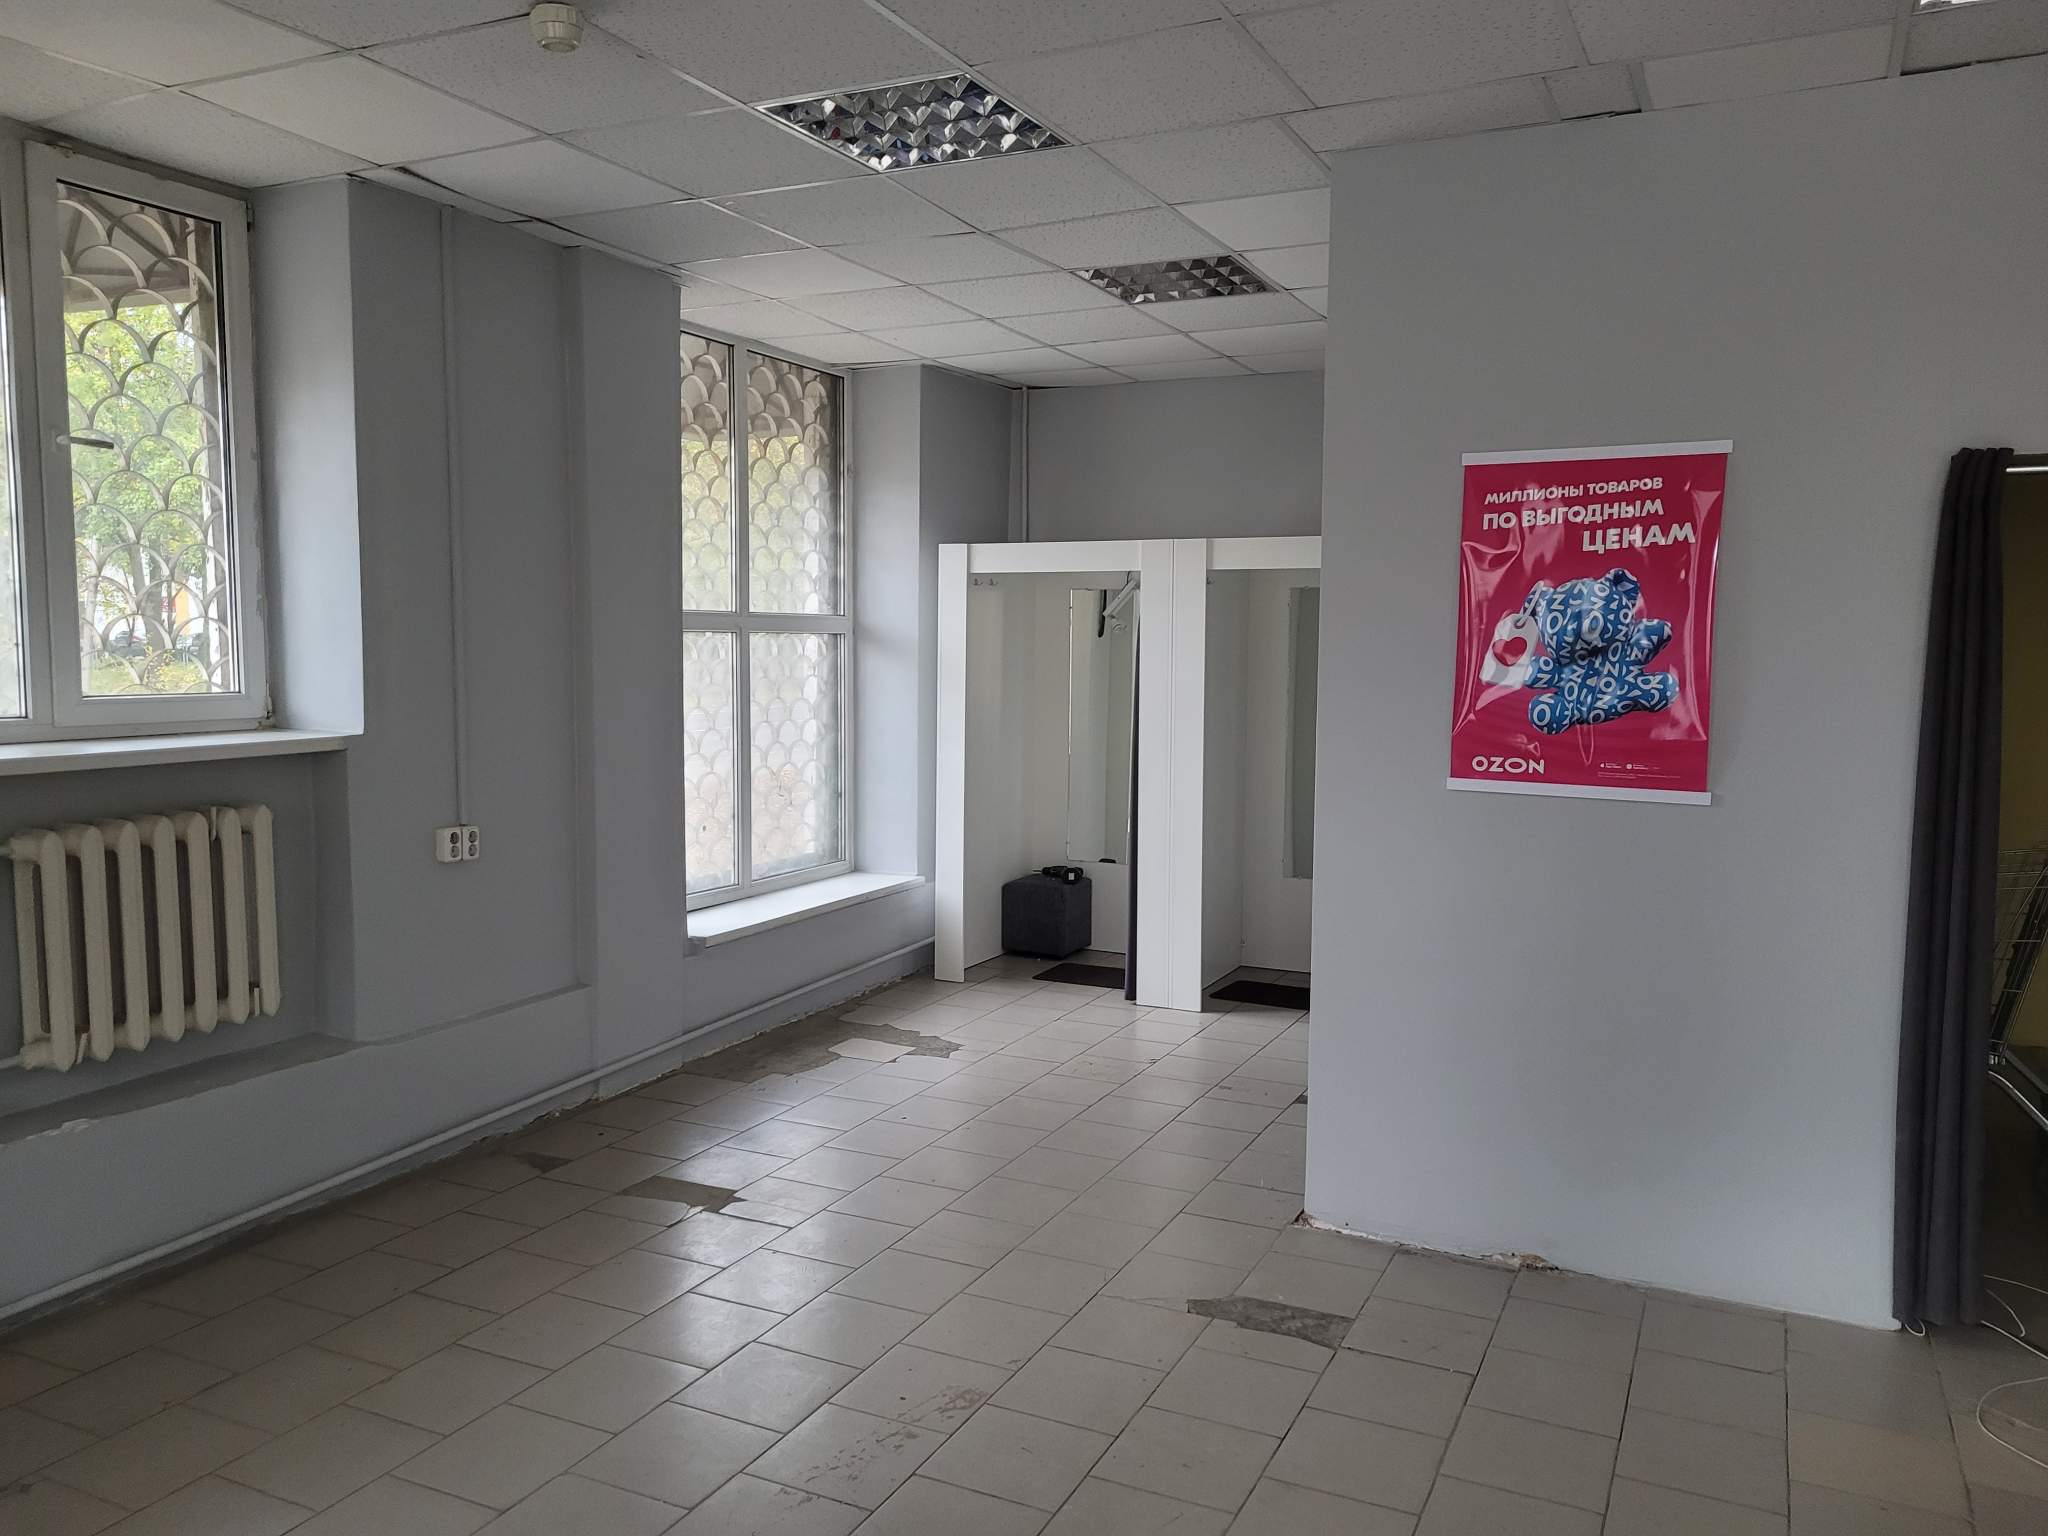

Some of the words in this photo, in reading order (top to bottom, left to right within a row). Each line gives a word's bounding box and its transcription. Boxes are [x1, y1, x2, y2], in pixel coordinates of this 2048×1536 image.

[1484, 484, 1583, 505] МИЛЛИОНЫ
[1587, 477, 1663, 496] ТОВАРОВ
[1482, 511, 1517, 530] ПО
[1521, 498, 1664, 527] ВЫГОДНЫМ
[1582, 522, 1696, 554] ЦЕНАМ
[1471, 755, 1545, 775] OZON
